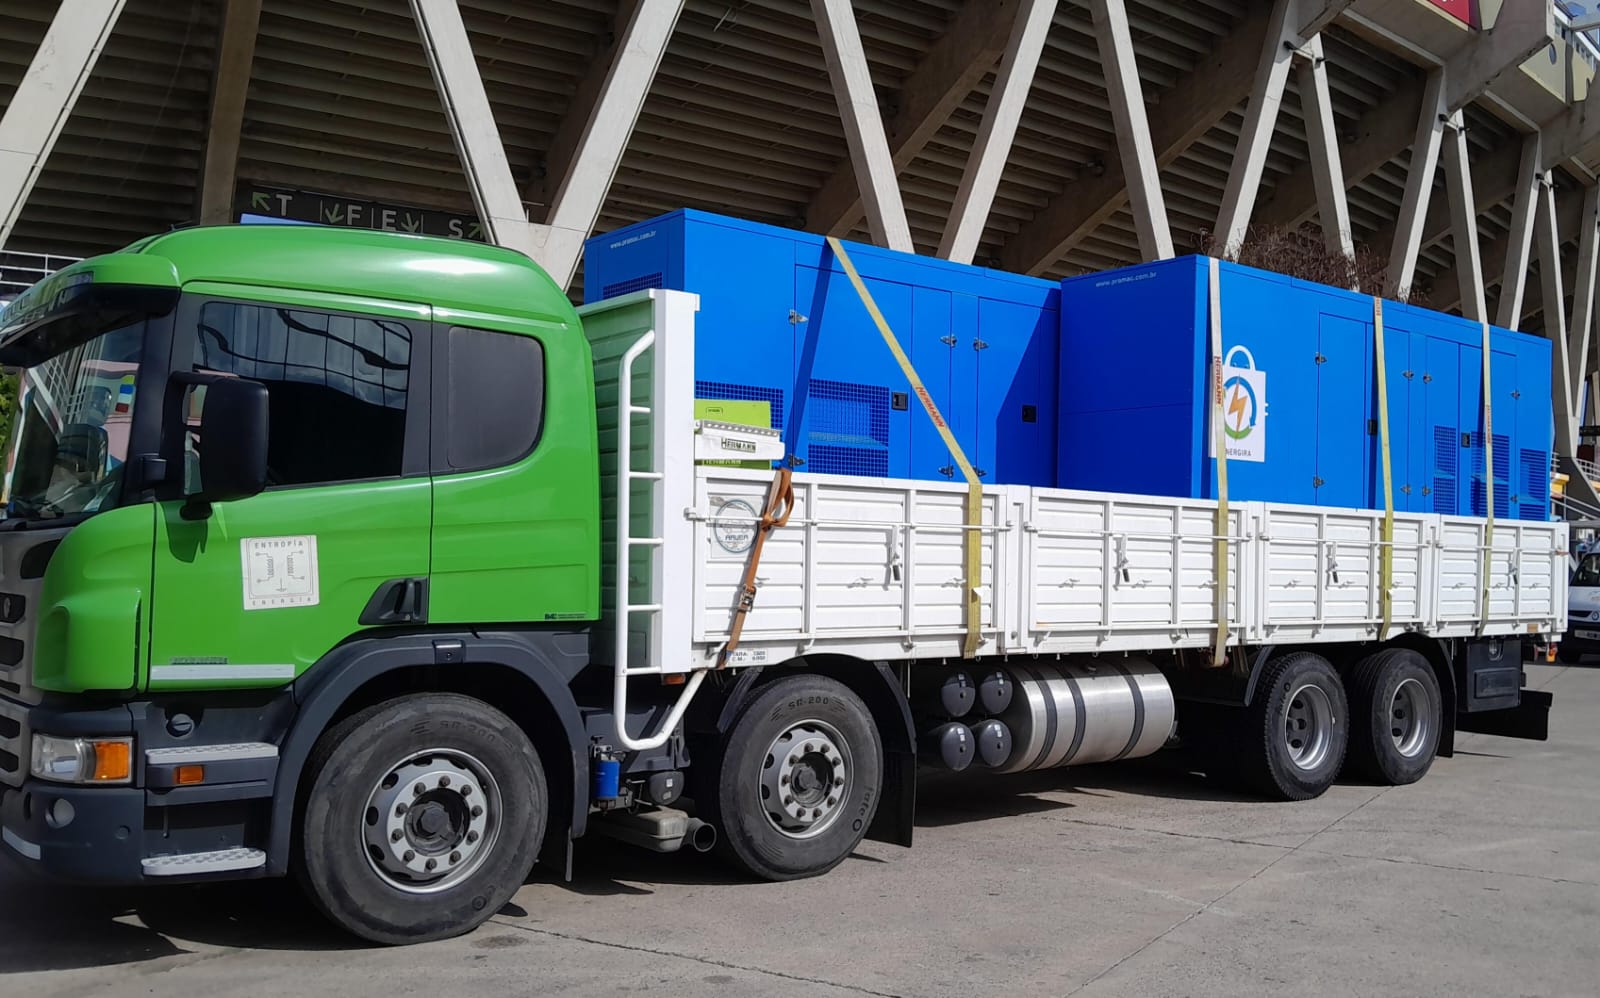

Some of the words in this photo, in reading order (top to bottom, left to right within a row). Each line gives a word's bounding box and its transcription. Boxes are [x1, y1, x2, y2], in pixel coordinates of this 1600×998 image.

[275, 194, 293, 216] T
[347, 204, 362, 226] F
[382, 210, 397, 231] E
[448, 218, 464, 240] S
[1226, 447, 1252, 457] NERGIRA
